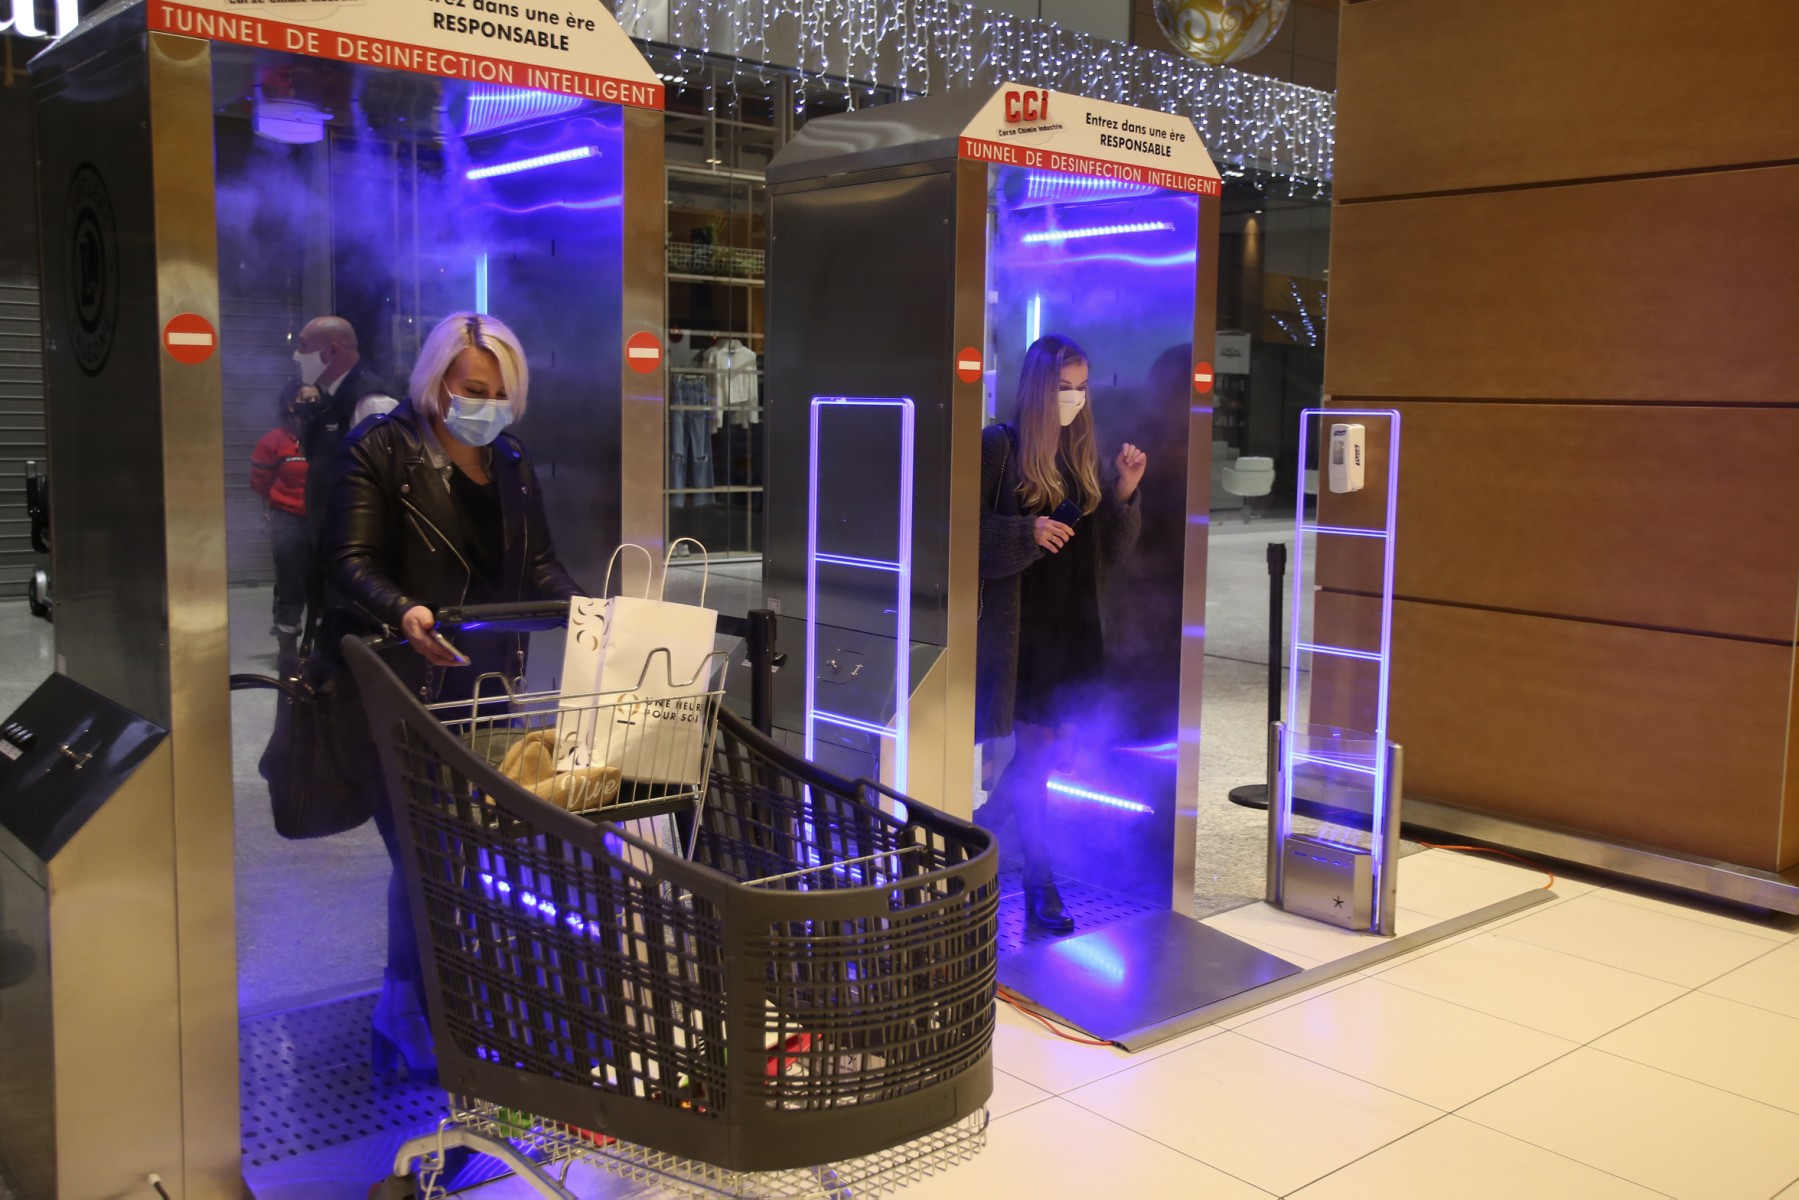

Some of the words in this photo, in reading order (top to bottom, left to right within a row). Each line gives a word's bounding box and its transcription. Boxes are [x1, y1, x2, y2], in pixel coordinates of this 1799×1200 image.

[433, 12, 569, 51] RESPONSABLE
[526, 9, 560, 25] une
[566, 12, 595, 31] ère
[162, 6, 268, 45] TUNNEL
[287, 28, 319, 53] DE
[337, 37, 513, 84] DESINFECTION
[528, 68, 656, 106] INTELLIGENT
[1086, 113, 1118, 130] Entrez
[1121, 119, 1146, 134] dans
[1149, 127, 1167, 139] une
[1170, 129, 1186, 142] ère
[1100, 133, 1171, 157] RESPONSABLE
[966, 141, 1017, 163] TUNNEL
[1026, 150, 1043, 166] DE
[1051, 155, 1142, 182] DESINFECTION
[1148, 170, 1217, 194] INTELLIGENT
[644, 708, 676, 720] POUR
